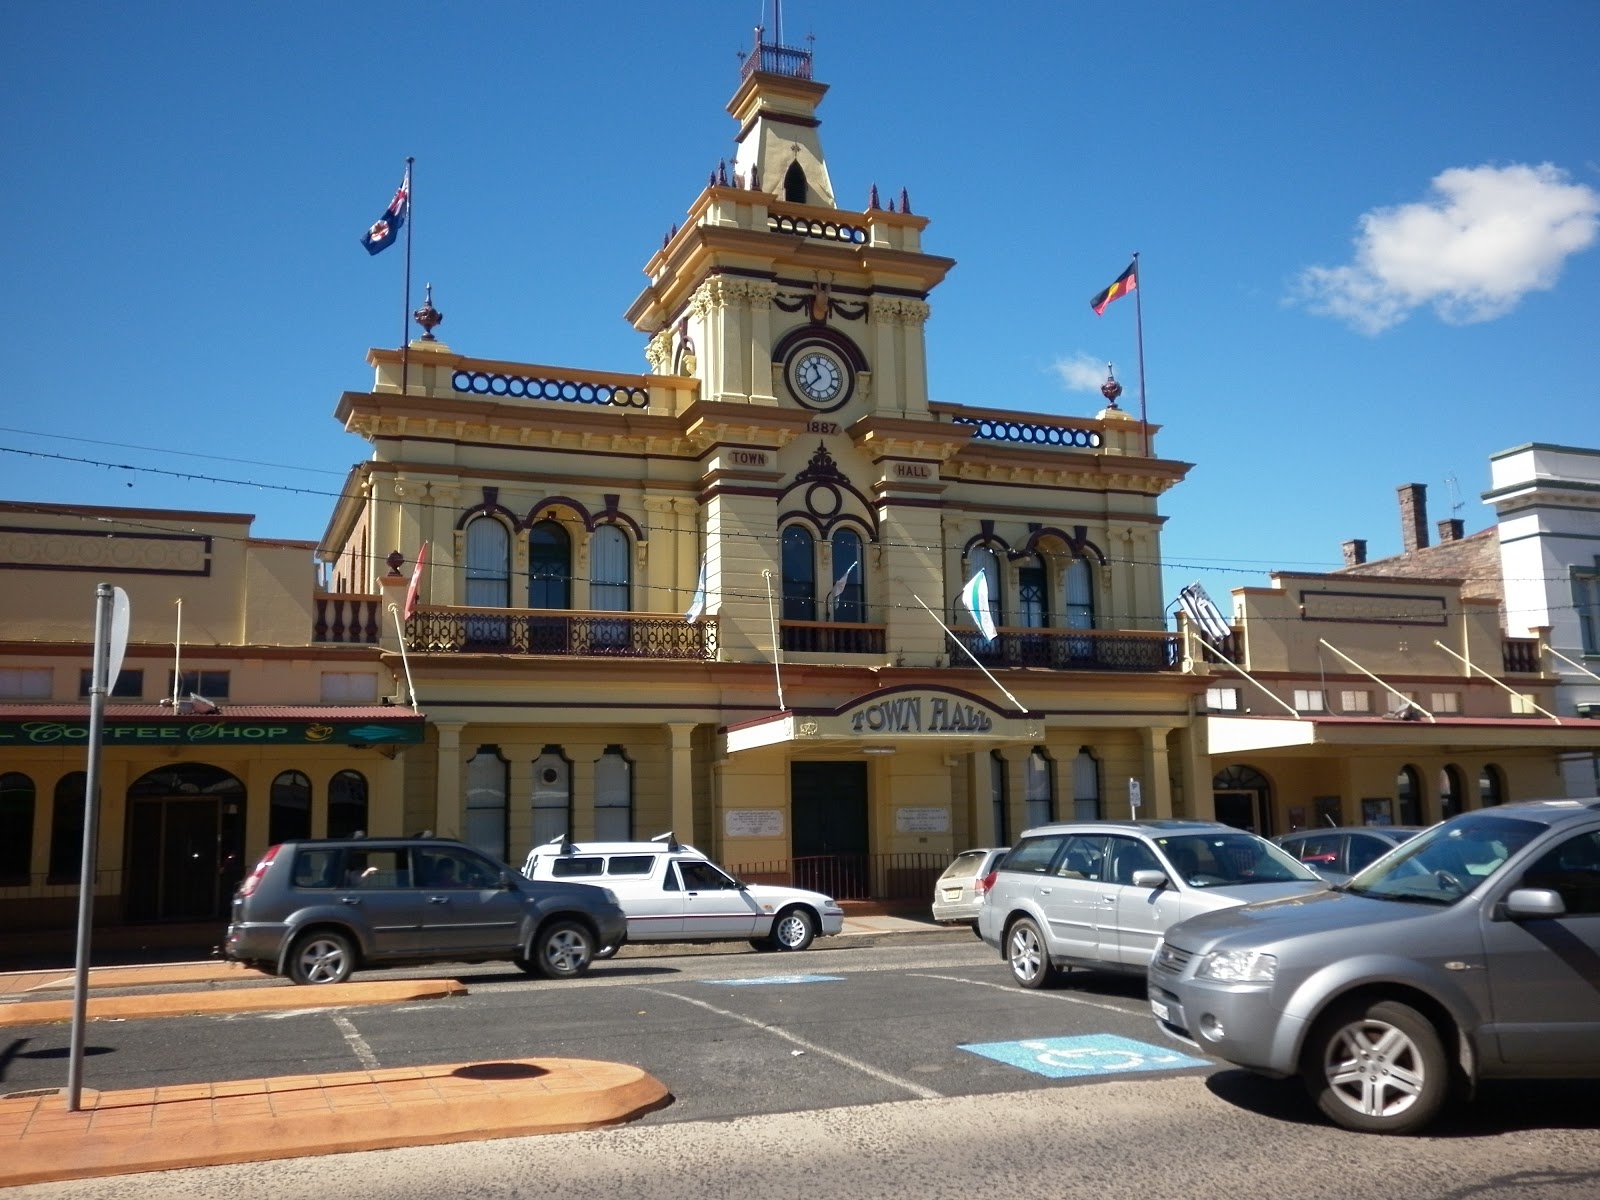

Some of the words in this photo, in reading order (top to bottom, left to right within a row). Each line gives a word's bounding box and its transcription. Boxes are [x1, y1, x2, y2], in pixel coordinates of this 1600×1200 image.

[806, 422, 838, 434] 1887
[732, 451, 765, 465] TOWN
[898, 465, 928, 477] HALL
[851, 696, 922, 733] TOWN
[928, 697, 993, 733] HALL
[187, 721, 288, 742] SHOP
